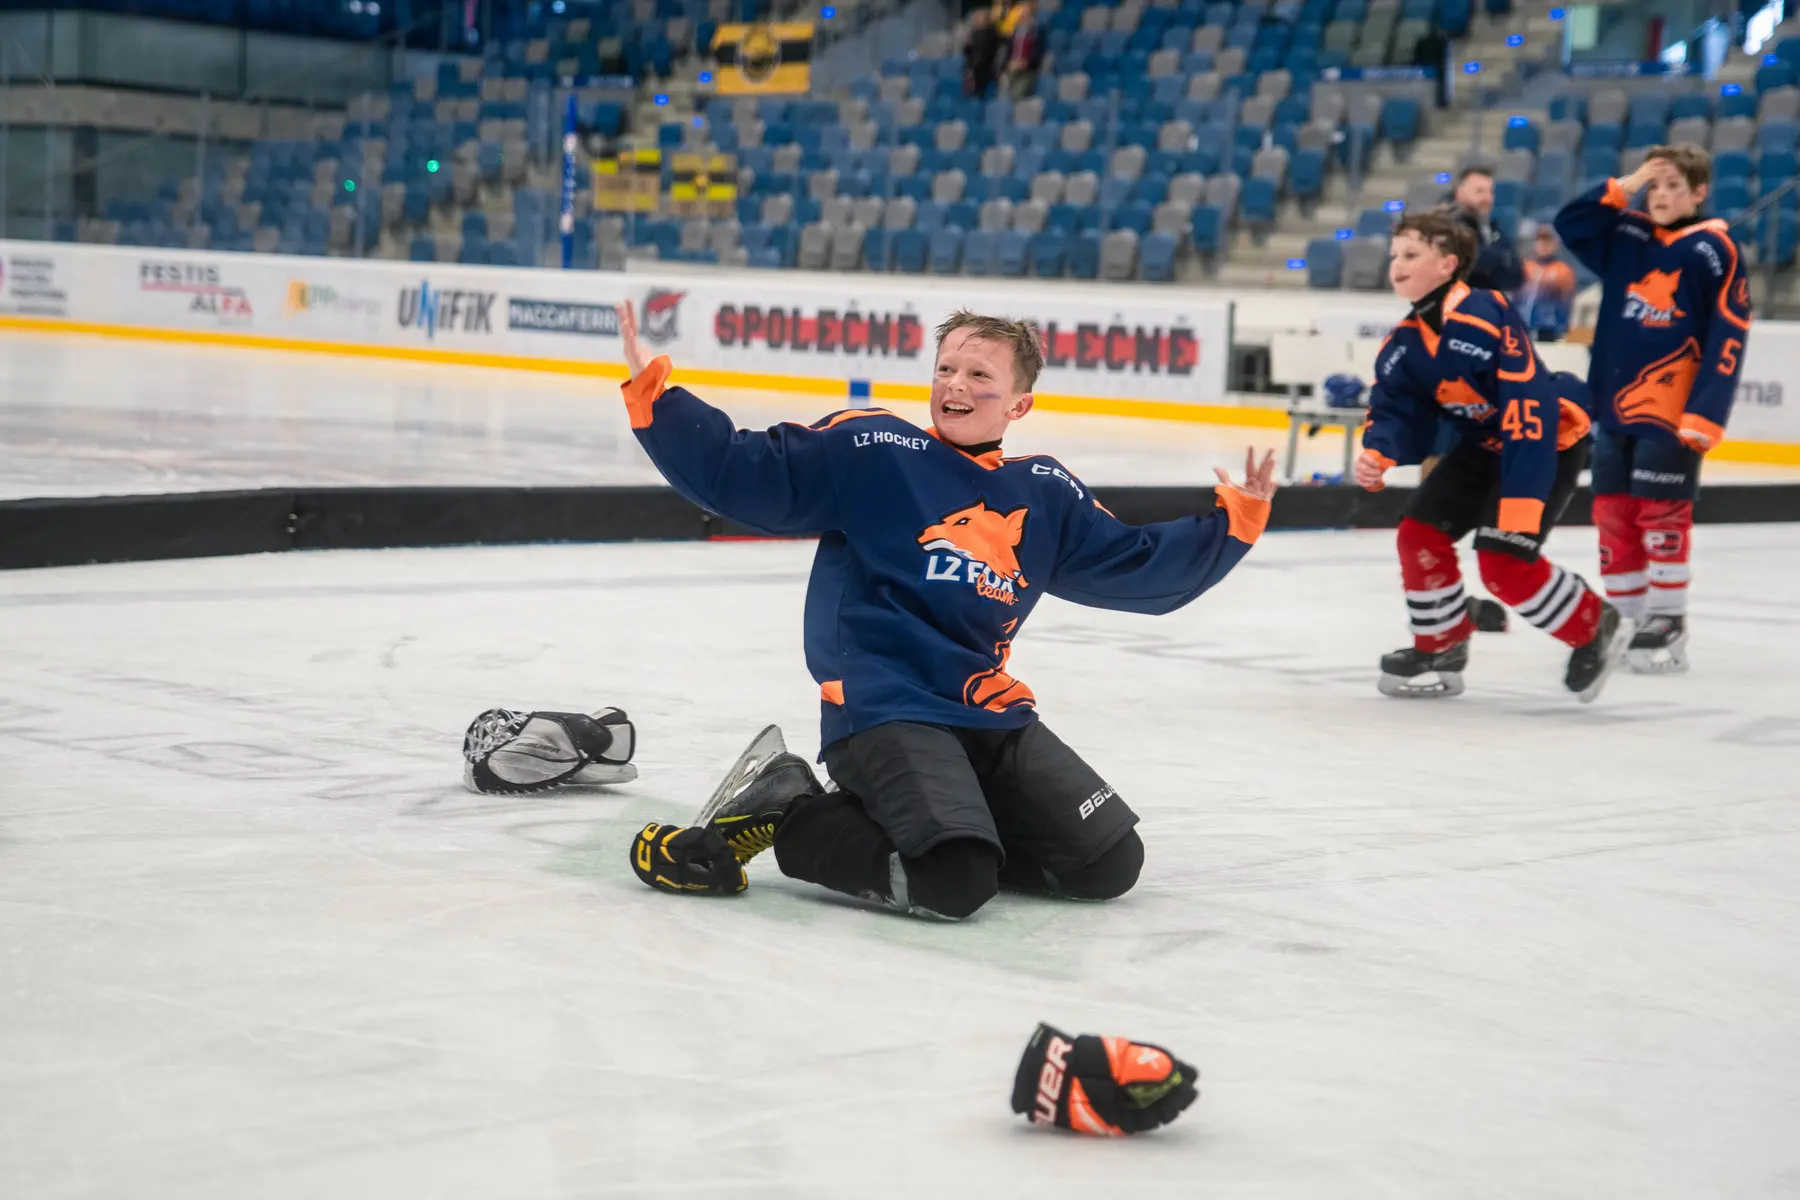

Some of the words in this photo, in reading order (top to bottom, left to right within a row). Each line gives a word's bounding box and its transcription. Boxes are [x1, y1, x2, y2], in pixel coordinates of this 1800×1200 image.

[139, 261, 219, 285] FESTIS
[509, 304, 618, 331] MACCAFERR
[716, 299, 923, 358] SPOLEČNĚ
[1045, 312, 1196, 376] LEČNĚ
[1448, 338, 1492, 361] CCM
[1717, 337, 1742, 376] 5
[1502, 398, 1543, 441] 45
[854, 432, 870, 448] LZ
[873, 431, 930, 451] HOCKEY
[1031, 463, 1084, 500] CCM
[926, 555, 961, 582] LZ
[976, 573, 1019, 606] team
[1033, 1035, 1074, 1125] UER
